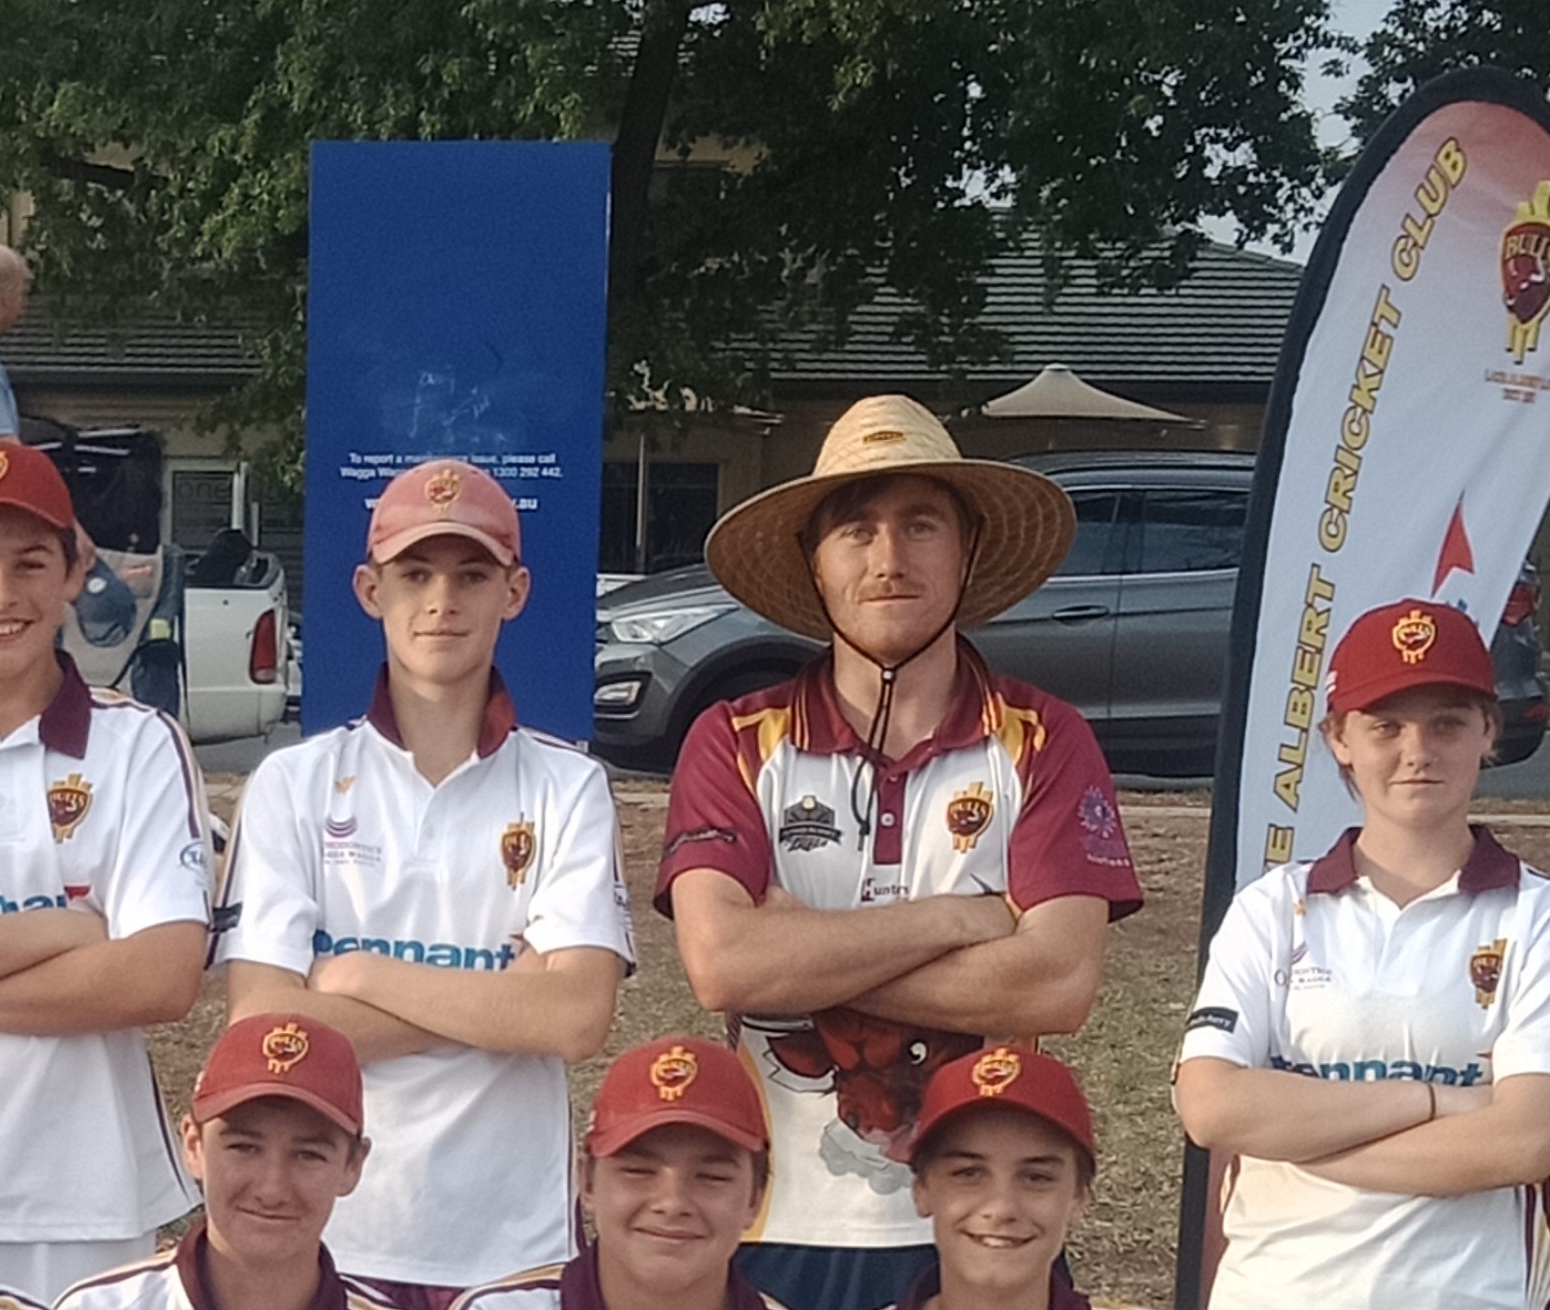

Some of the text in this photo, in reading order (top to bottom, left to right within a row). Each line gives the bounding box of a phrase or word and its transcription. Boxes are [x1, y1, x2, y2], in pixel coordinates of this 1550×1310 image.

[348, 453, 362, 464] To
[363, 454, 394, 466] report
[340, 467, 376, 480] Wagga
[1273, 562, 1336, 813] ALBERT
[1318, 284, 1403, 553] CRICKET
[1391, 136, 1468, 281] CLUB
